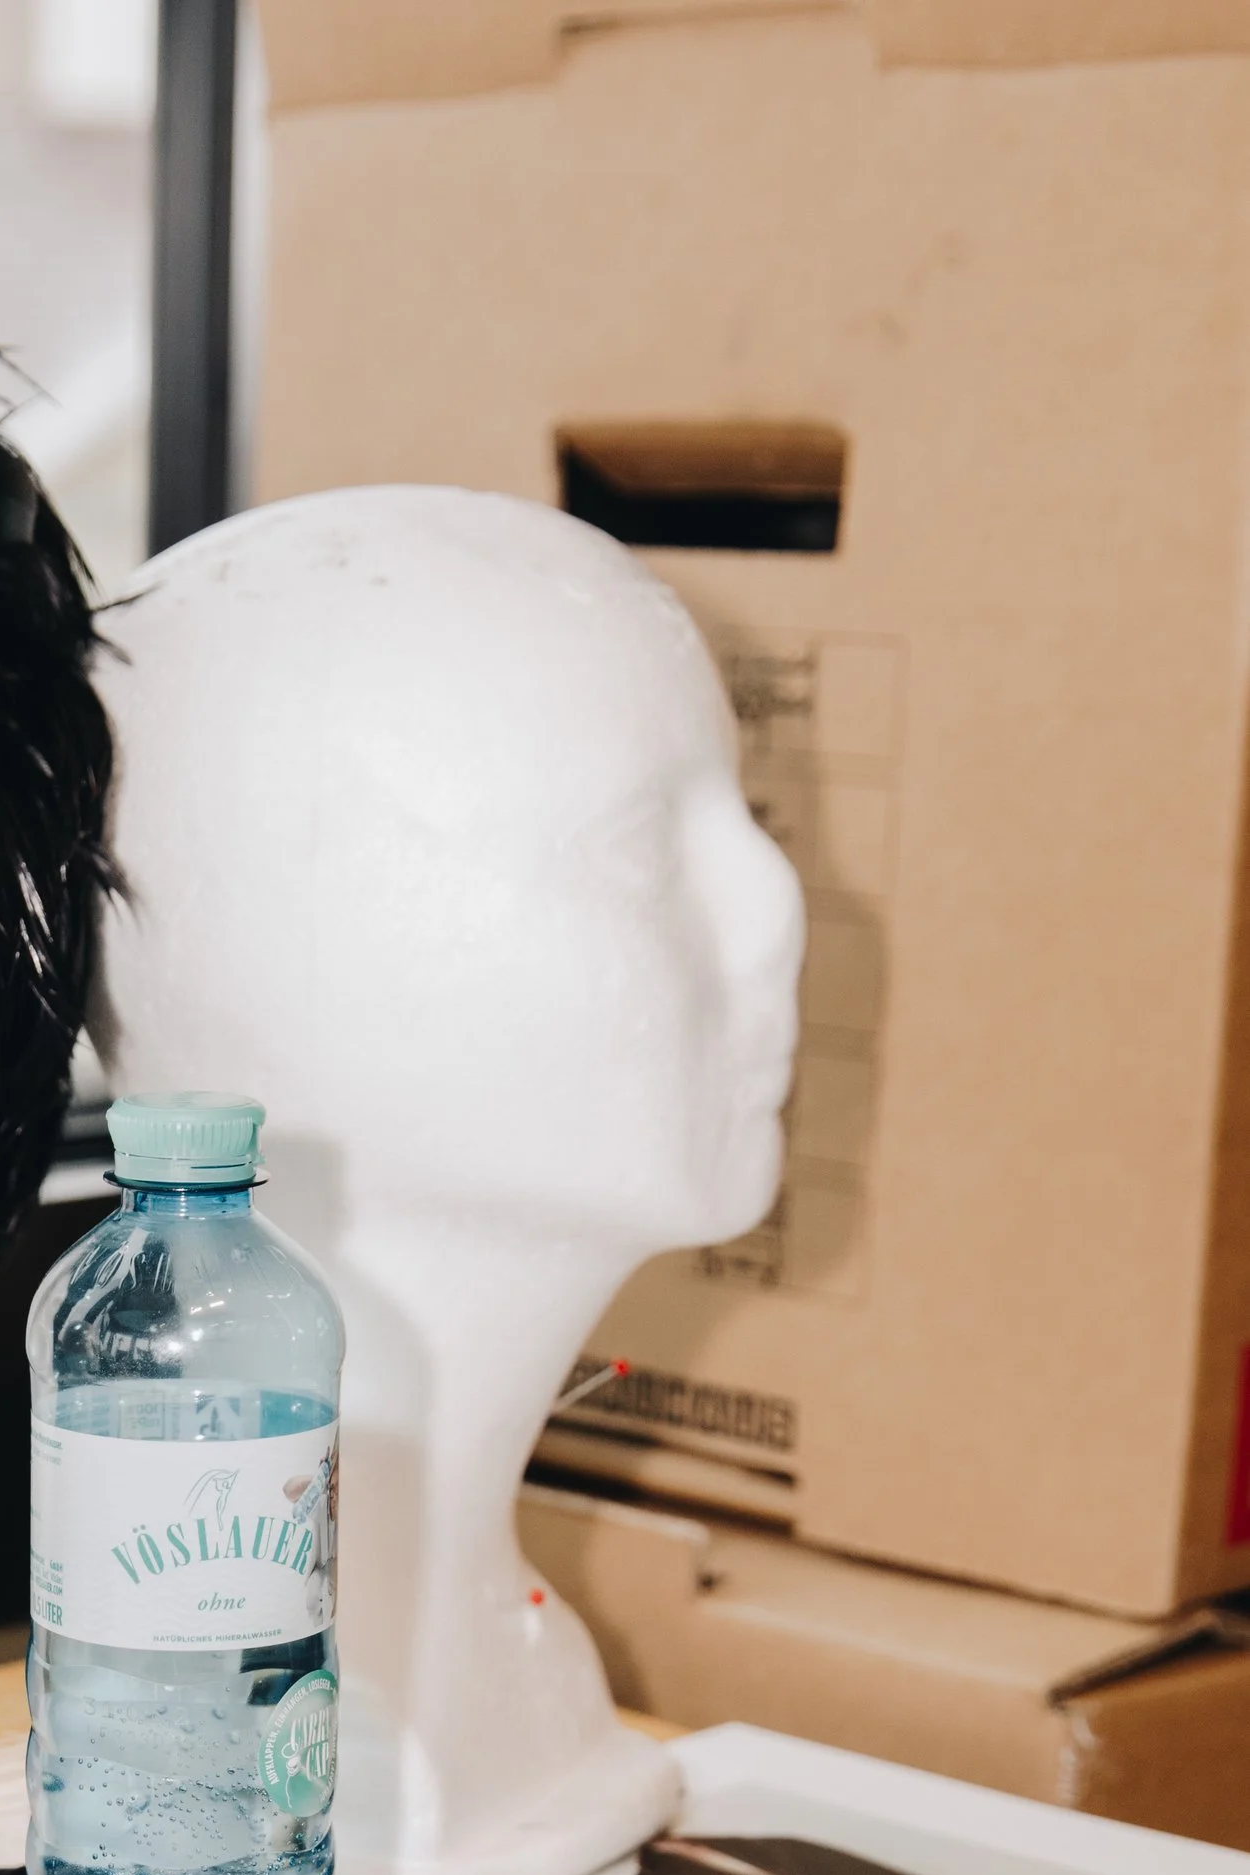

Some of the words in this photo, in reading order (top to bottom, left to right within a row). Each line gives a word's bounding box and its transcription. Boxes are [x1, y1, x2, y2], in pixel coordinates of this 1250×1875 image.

[111, 1515, 313, 1585] VÖSLAUER
[42, 1597, 63, 1626] LITER
[197, 1593, 246, 1613] ohne
[152, 1634, 213, 1643] NATÜRLICHES
[216, 1628, 283, 1643] MINERALWASSER
[305, 1742, 330, 1782] CAP
